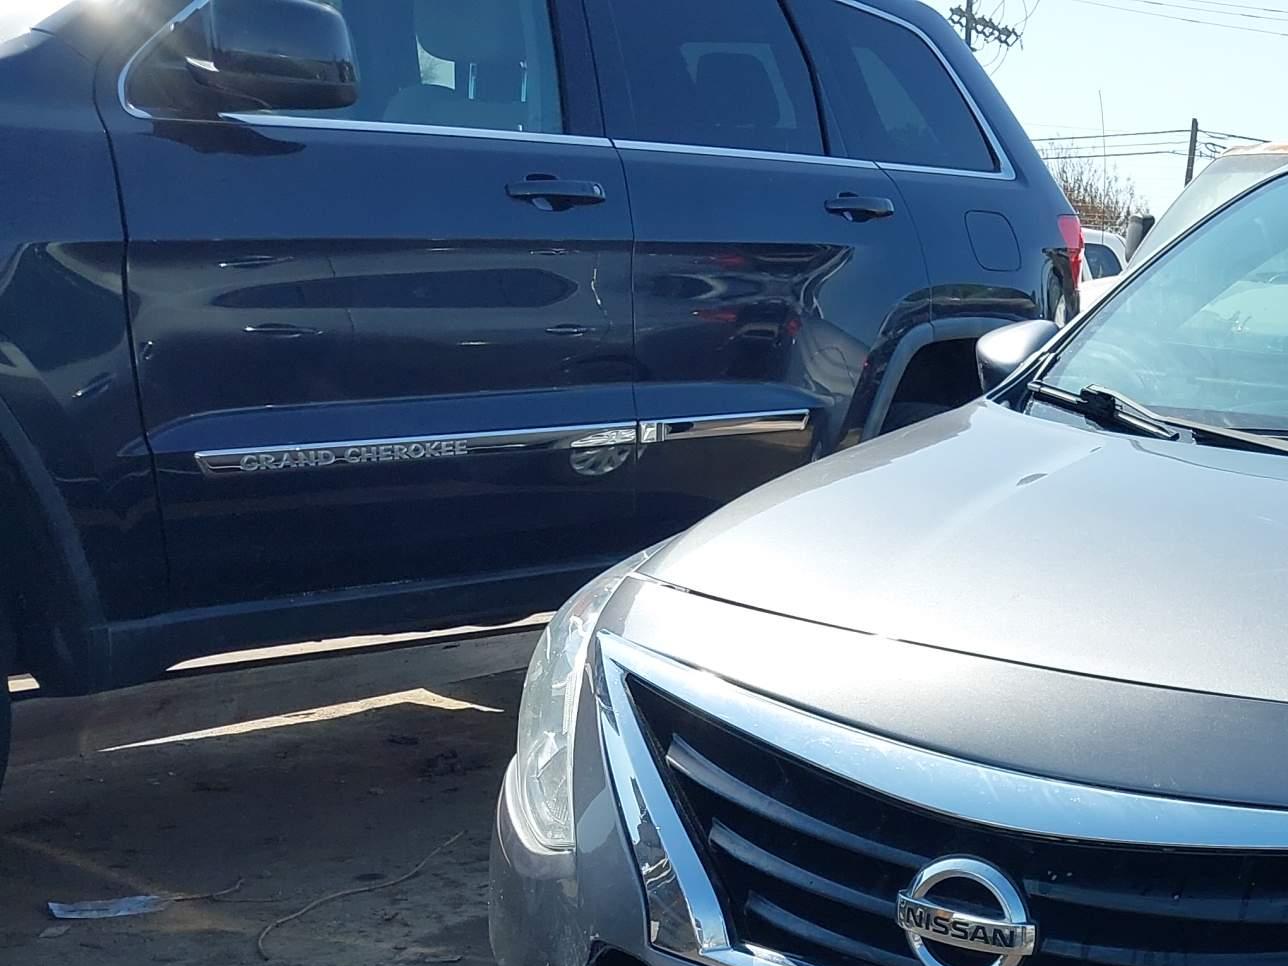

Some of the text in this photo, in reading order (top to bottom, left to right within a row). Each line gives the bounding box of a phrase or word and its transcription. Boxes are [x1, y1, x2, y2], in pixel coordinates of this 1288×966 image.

[240, 439, 469, 471] GRAND CHEROKEE
[907, 908, 1014, 946] NISSAN
